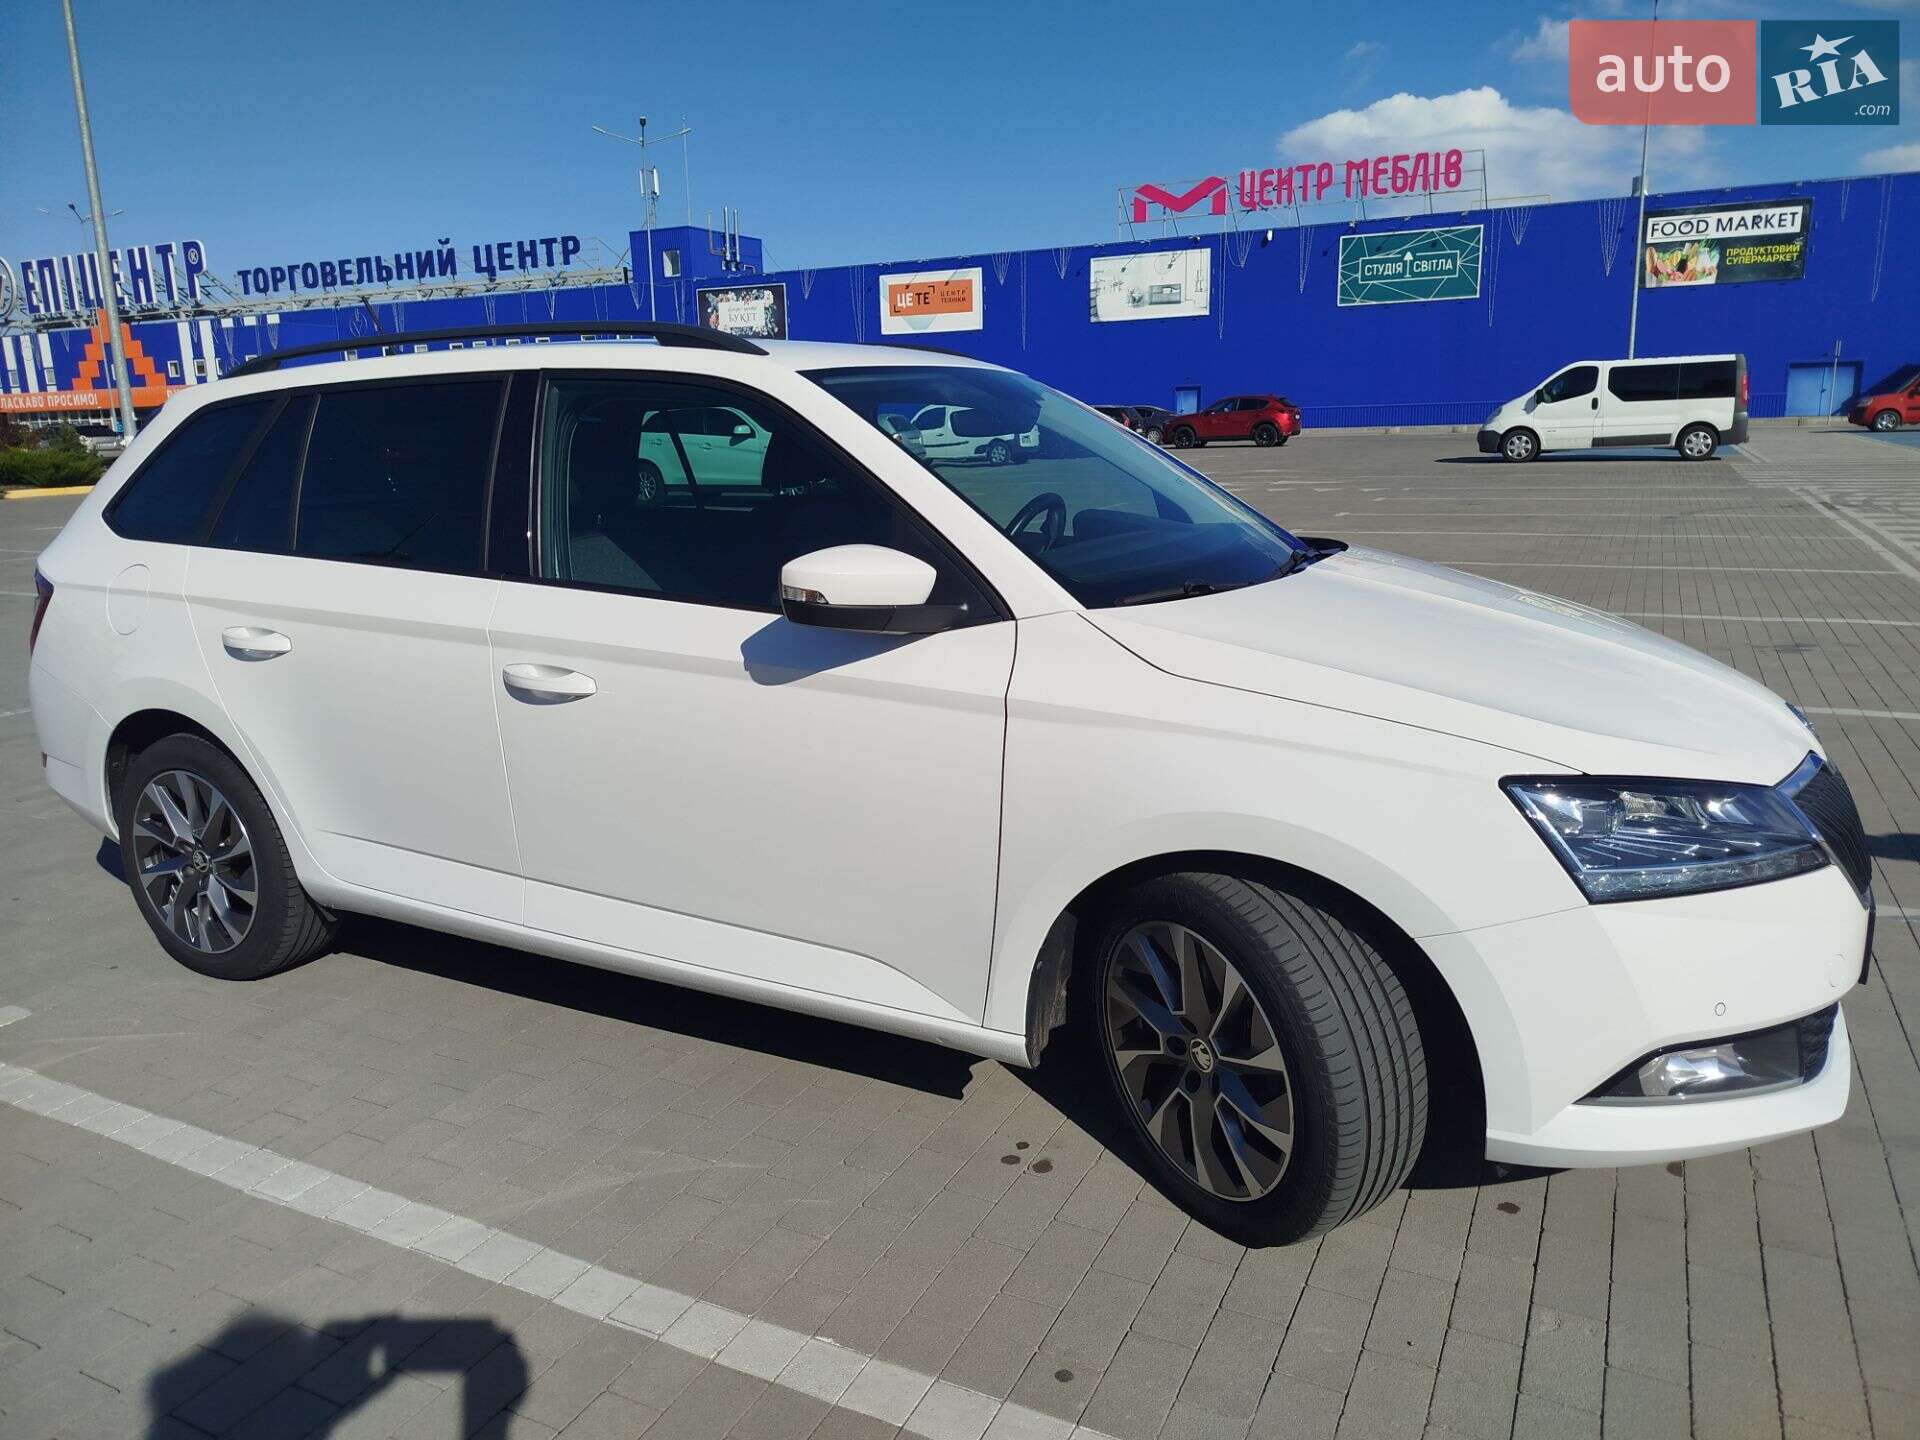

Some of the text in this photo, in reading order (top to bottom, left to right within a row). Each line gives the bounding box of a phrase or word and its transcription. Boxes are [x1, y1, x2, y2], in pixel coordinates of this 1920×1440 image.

[1239, 149, 1463, 211] ЦЕНТР МЕБЛІВ
[1650, 211, 1799, 238] FOOD MARKET
[237, 235, 581, 295] ТОРГОВЕЛЬНИЙ ЦЕНТР
[1364, 258, 1453, 276] СТУДІЯ СВІТЛА
[1725, 252, 1799, 266] СУПЕРМАРКЕТ
